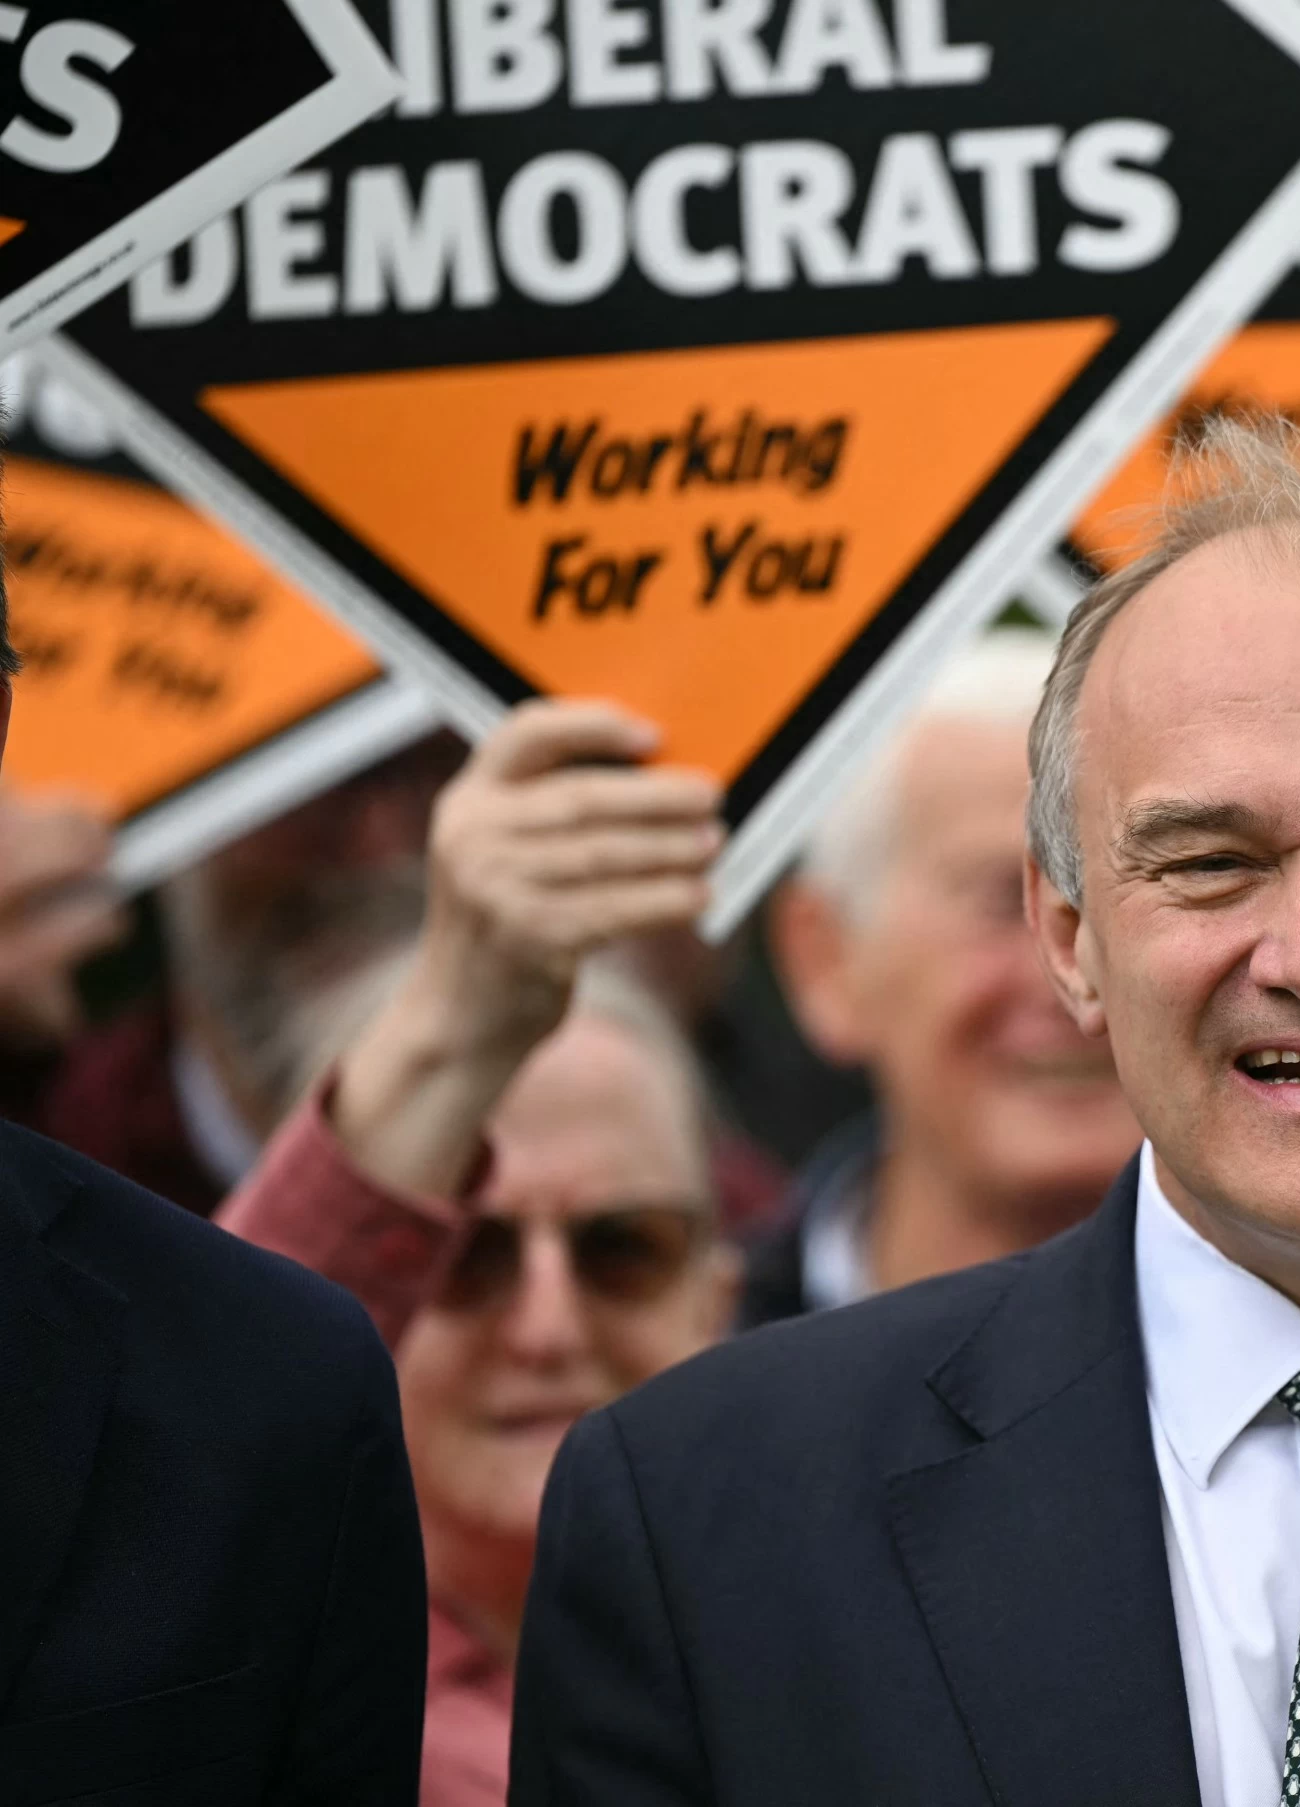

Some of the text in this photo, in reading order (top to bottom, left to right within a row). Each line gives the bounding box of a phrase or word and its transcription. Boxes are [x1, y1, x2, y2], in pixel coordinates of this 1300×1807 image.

[0, 3, 136, 172] S
[372, 0, 994, 119] IBERAL
[512, 408, 853, 508] Working
[532, 523, 846, 623] For You
